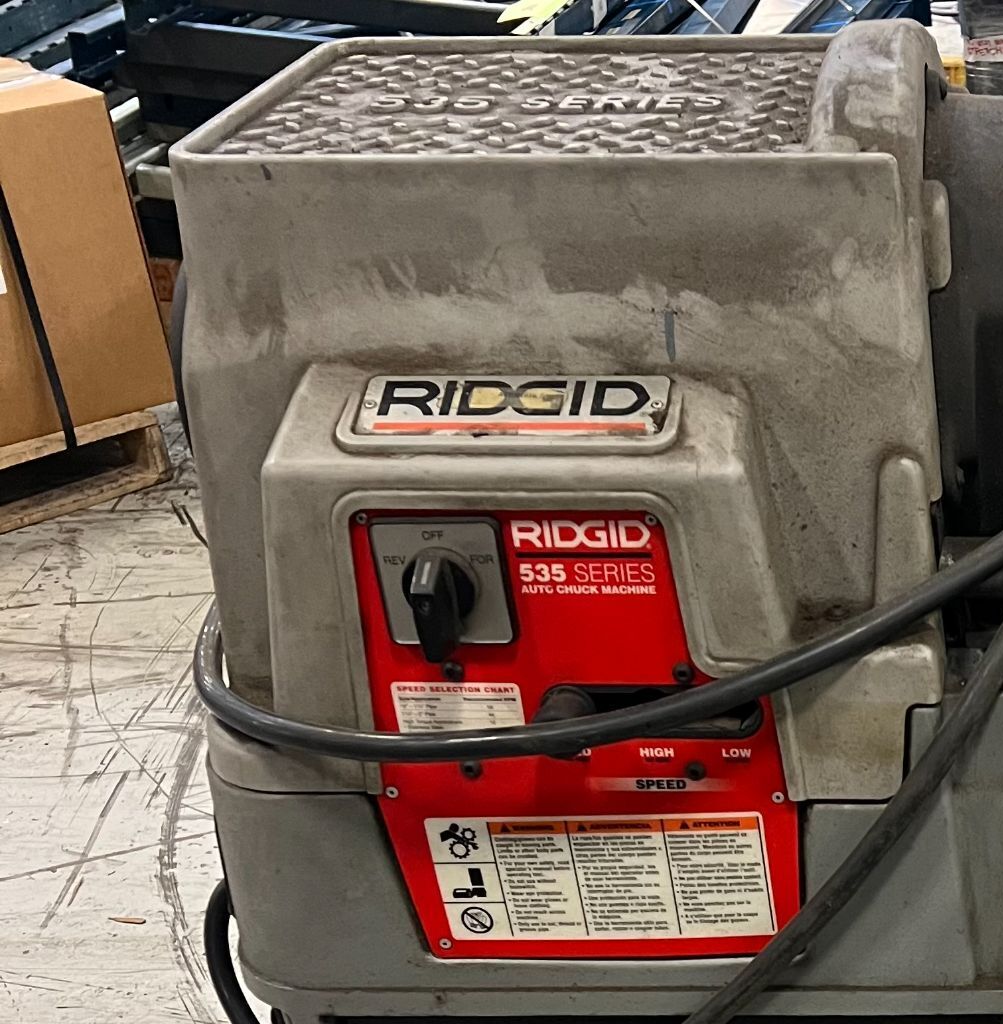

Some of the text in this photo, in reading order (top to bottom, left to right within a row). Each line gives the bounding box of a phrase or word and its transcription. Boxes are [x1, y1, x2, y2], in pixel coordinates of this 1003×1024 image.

[369, 94, 723, 114] 535 SERIES
[376, 380, 651, 416] RIDGID
[421, 530, 443, 541] OFF
[510, 520, 651, 548] RIDGID
[383, 554, 494, 565] REV FOR
[519, 563, 656, 583] 535 SERIES
[521, 585, 657, 595] AUTO CHUCK MACHINE
[640, 747, 751, 758] HIGH LOW
[636, 779, 686, 790] SPEED
